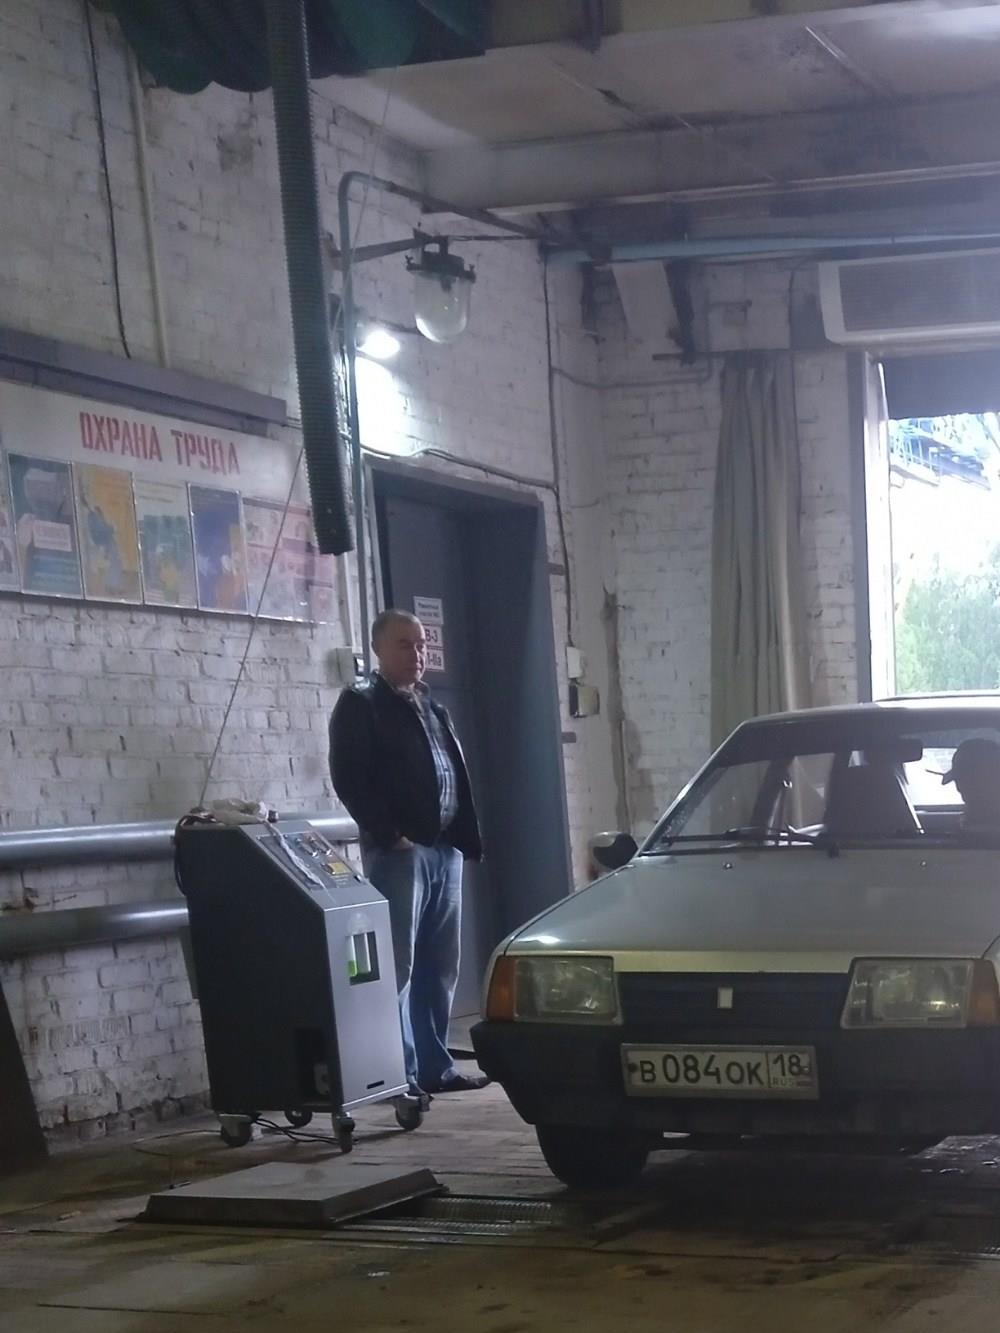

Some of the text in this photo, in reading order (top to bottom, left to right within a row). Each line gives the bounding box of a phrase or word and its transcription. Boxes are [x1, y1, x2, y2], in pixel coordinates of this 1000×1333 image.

[79, 412, 241, 475] ОХРАНА ТРУДА
[773, 1053, 801, 1077] 18
